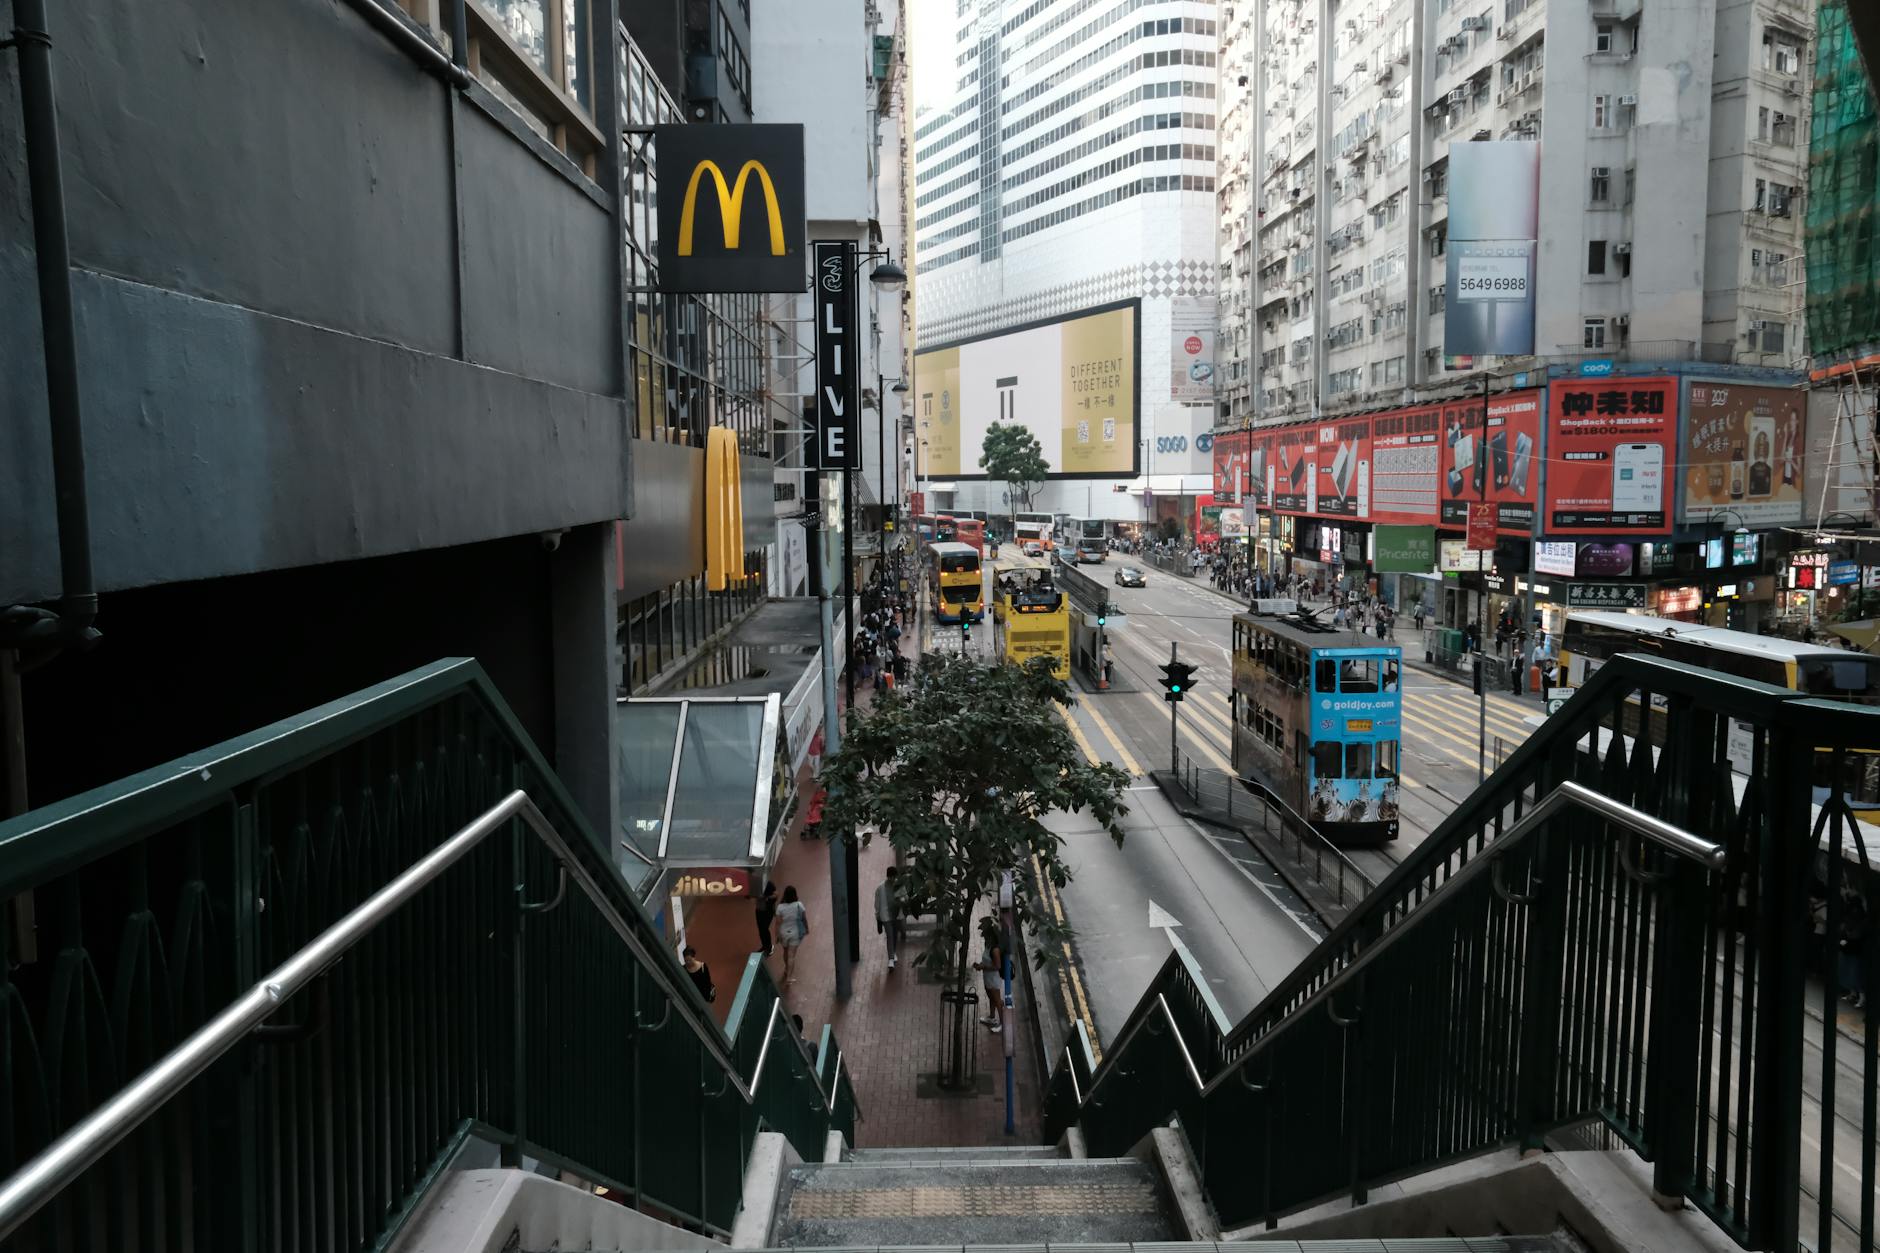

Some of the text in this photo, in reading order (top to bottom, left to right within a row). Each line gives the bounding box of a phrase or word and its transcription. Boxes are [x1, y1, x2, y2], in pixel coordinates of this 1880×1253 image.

[1460, 278, 1526, 290] 5649 6988
[1071, 358, 1122, 378] DIFFERENT
[824, 302, 845, 458] LIVE
[1073, 374, 1120, 392] TOGETHER
[1560, 418, 1606, 427] ShopBack
[1574, 427, 1618, 435] $1800
[1157, 435, 1188, 454] SOGO
[1378, 547, 1429, 560] Pricerite
[1333, 700, 1395, 711] goldjoy.com
